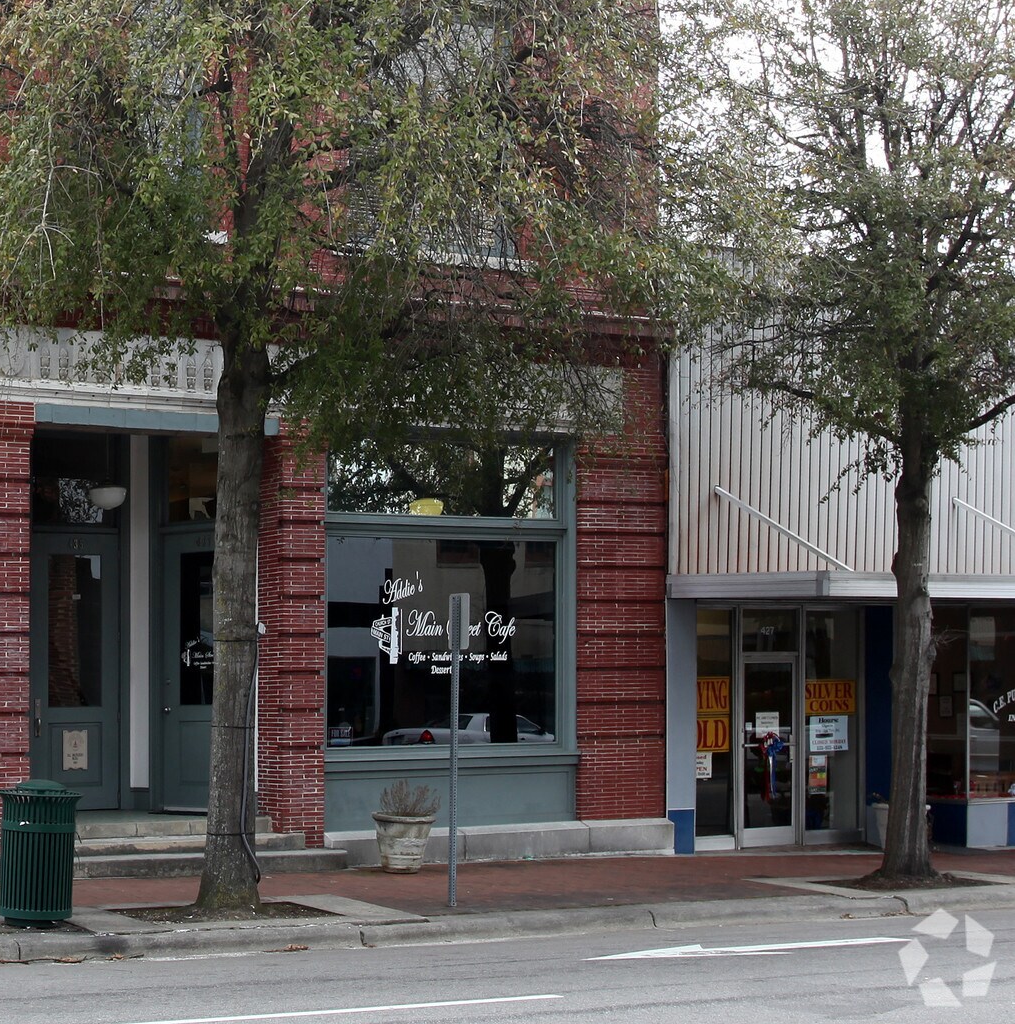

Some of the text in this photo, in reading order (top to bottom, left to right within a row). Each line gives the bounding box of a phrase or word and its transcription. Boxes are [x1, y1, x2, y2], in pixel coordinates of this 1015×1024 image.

[382, 570, 423, 604] Addie's
[372, 628, 383, 638] MAIN
[406, 609, 443, 636] Main
[485, 611, 516, 645] Cafe
[761, 626, 774, 635] 427
[408, 652, 426, 664] Coffee
[469, 652, 485, 664] Soups
[490, 651, 507, 661] Salads
[805, 682, 853, 700] SILVER
[809, 699, 849, 712] COINS
